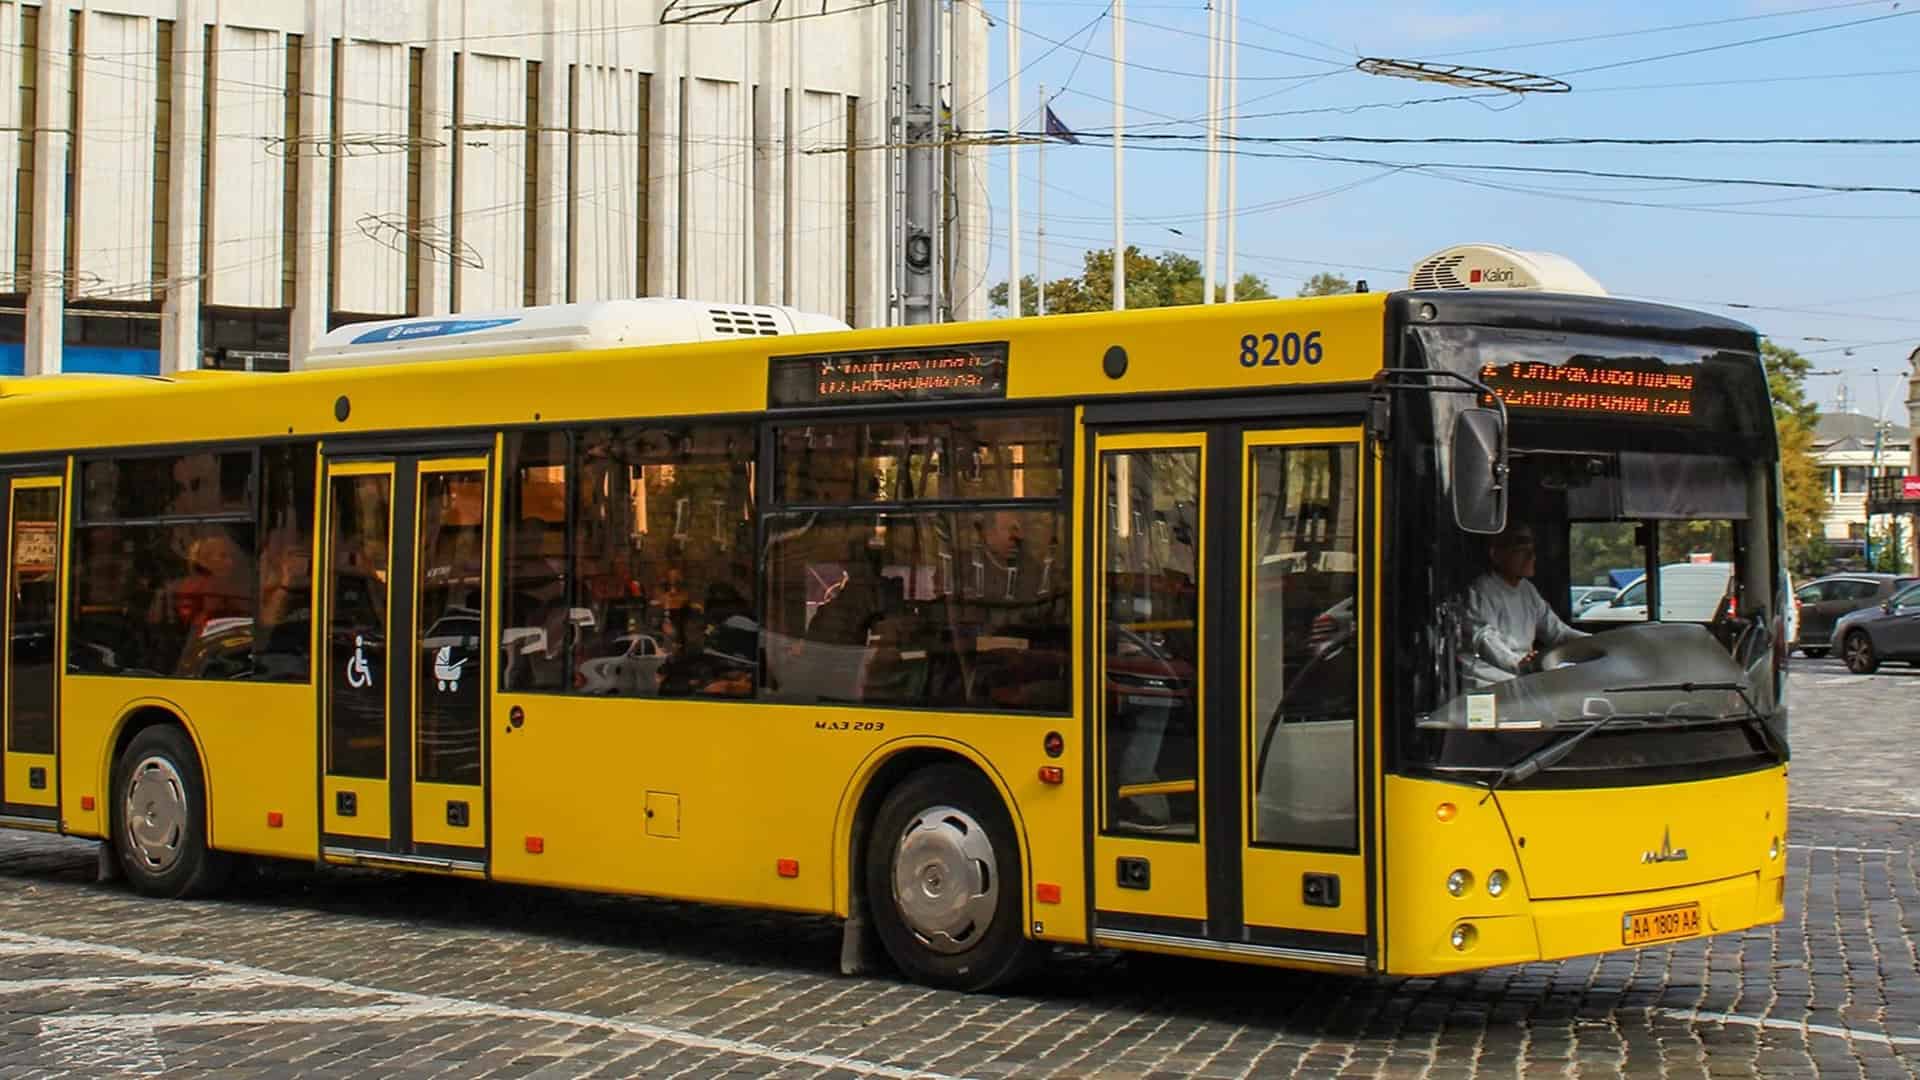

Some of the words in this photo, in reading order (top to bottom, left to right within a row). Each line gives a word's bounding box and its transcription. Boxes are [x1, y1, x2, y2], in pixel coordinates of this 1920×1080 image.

[1240, 330, 1323, 367] 8206
[854, 721, 885, 731] 203
[1654, 912, 1679, 935] 1809
